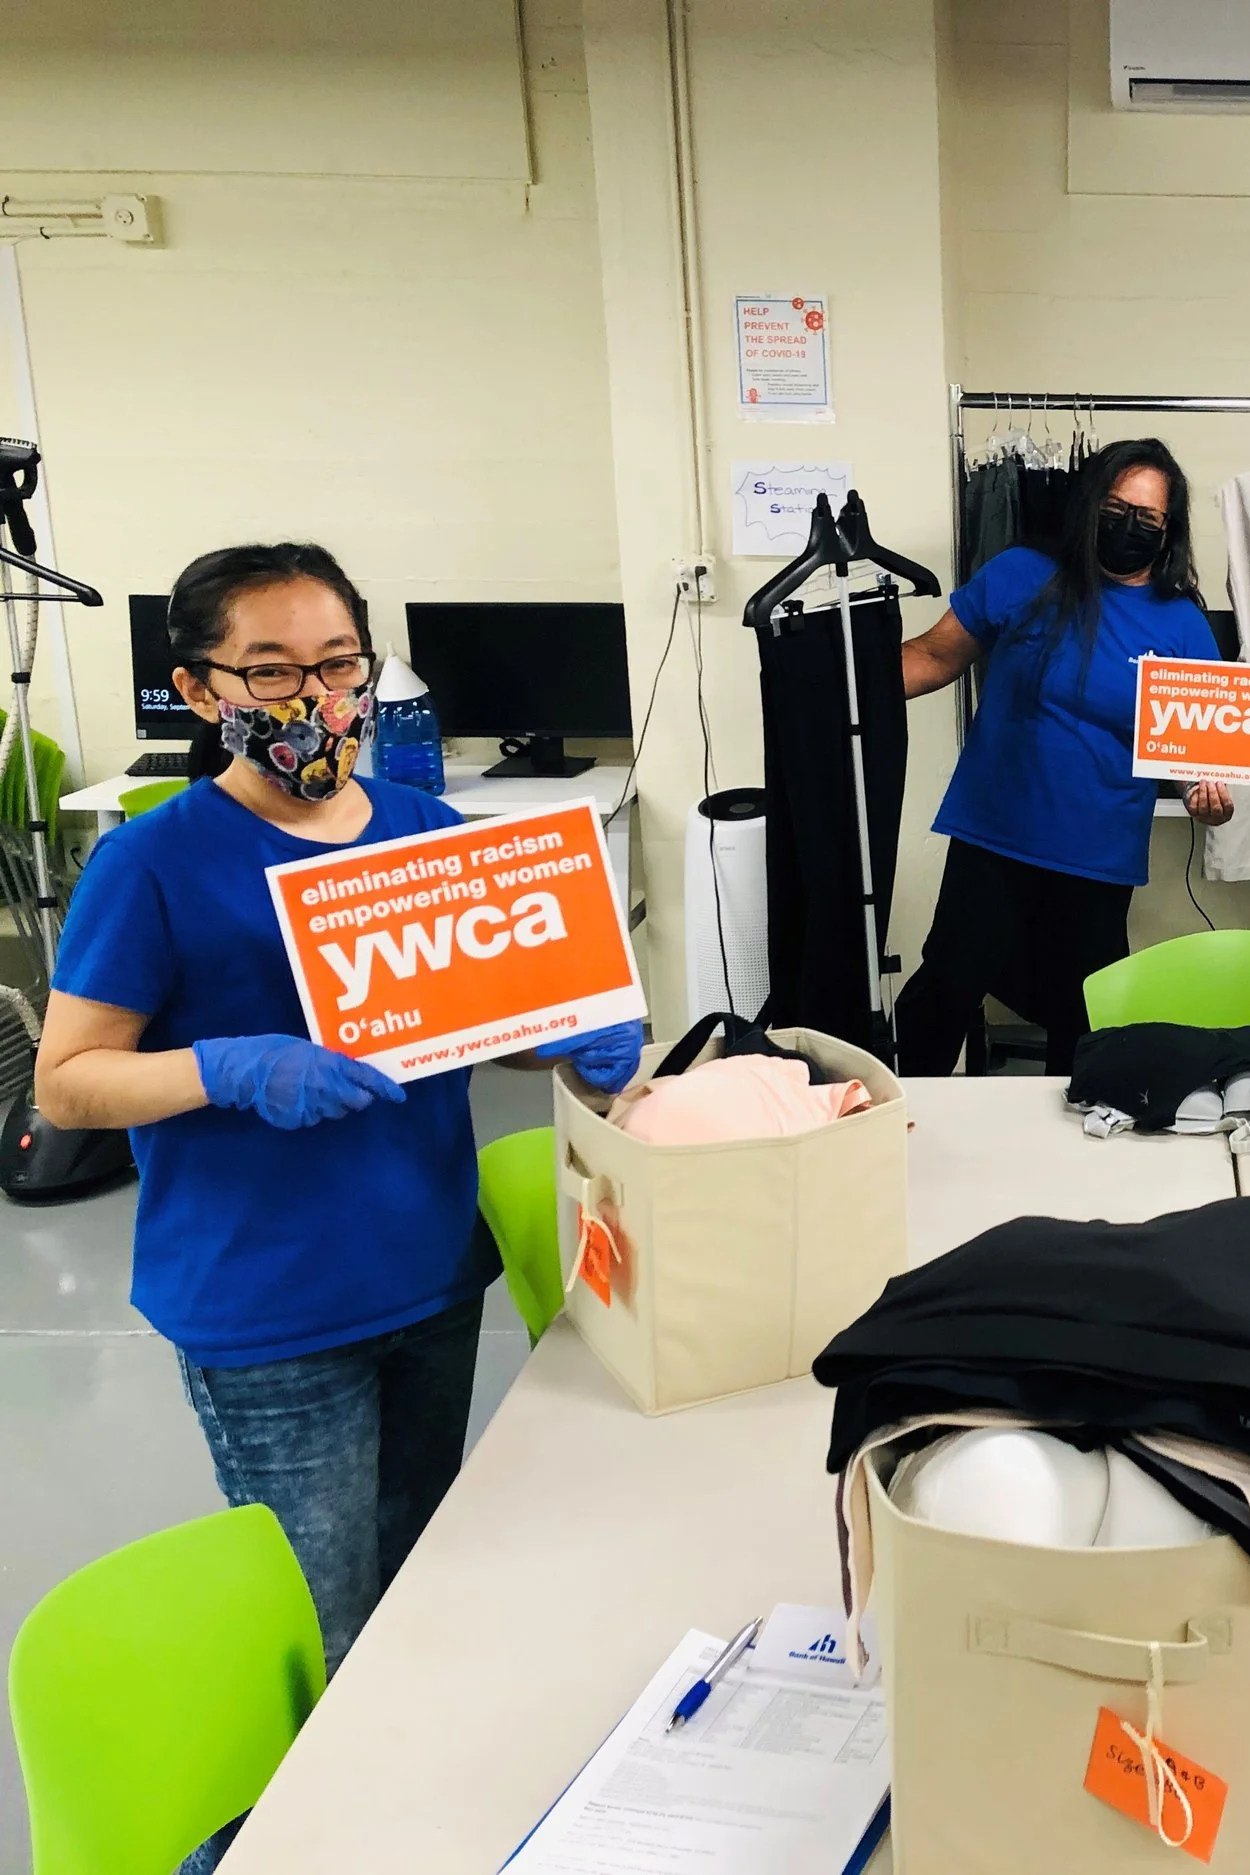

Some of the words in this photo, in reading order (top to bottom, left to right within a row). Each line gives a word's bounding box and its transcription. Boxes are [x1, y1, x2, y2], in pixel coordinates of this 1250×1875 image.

[743, 307, 770, 316] HELP
[744, 321, 790, 331] PREVENT
[745, 335, 764, 344] THE
[766, 335, 807, 345] SPREAD
[745, 349, 759, 358] OF
[761, 349, 806, 359] COVID-19
[770, 503, 814, 514] Statio
[1150, 668, 1229, 688] eliminating
[140, 688, 170, 703] 9:59
[1149, 684, 1237, 703] empowering
[301, 855, 463, 906] eliminating
[470, 831, 563, 867] racism
[309, 878, 487, 933] empowering
[493, 853, 592, 889] women
[318, 891, 568, 1012] ywca
[400, 1014, 578, 1069] www.ywcaoahu.org
[788, 1651, 809, 1660] Bank
[819, 1655, 847, 1665] Hawaii
